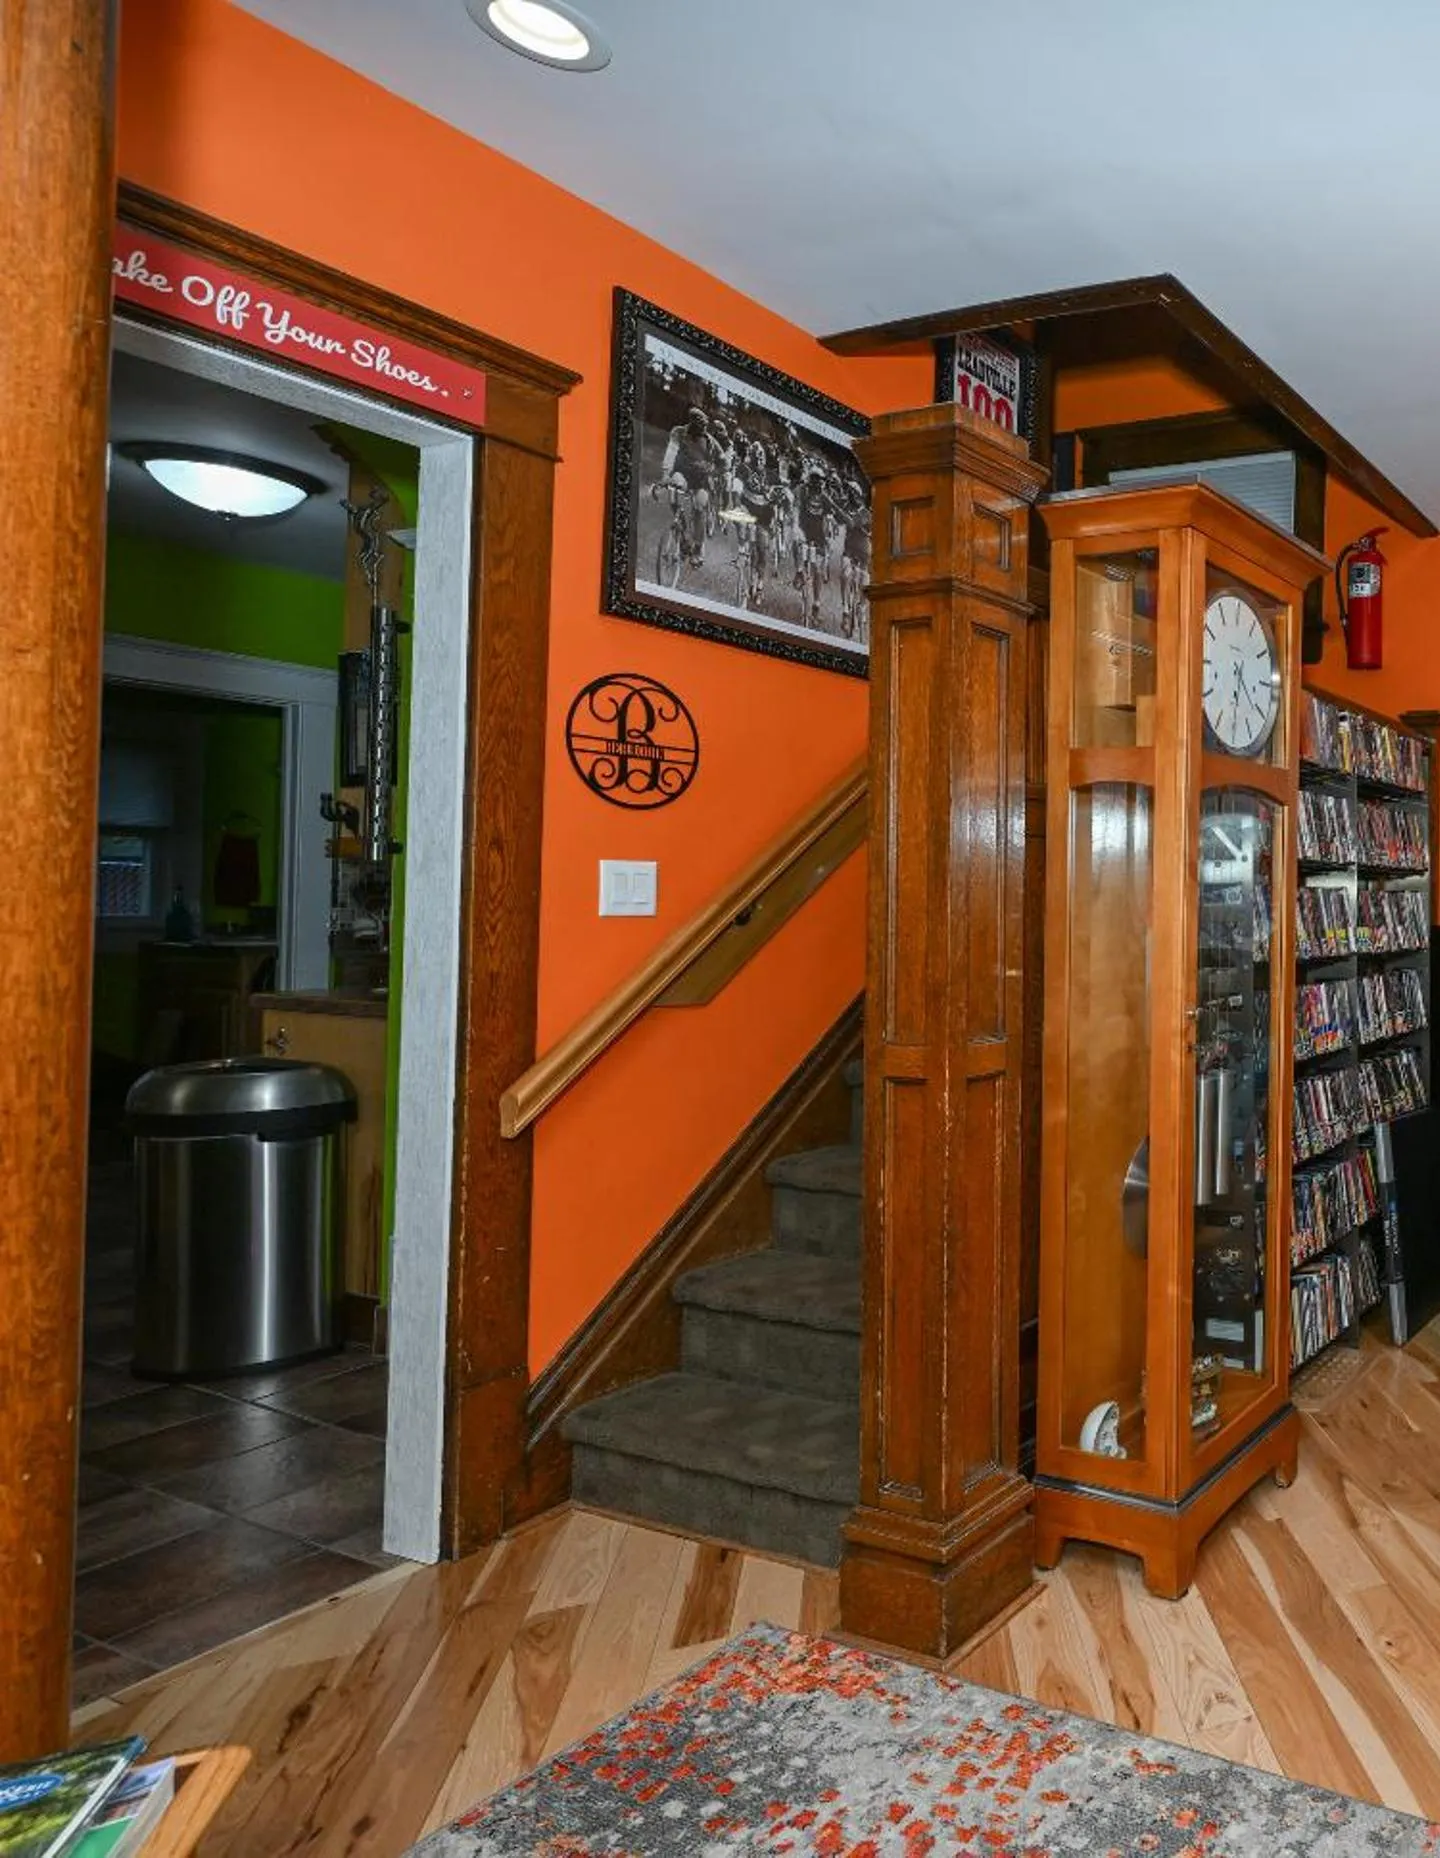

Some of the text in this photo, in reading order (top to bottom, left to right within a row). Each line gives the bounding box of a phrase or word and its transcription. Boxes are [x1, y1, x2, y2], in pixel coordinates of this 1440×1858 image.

[111, 250, 173, 292] ake
[181, 275, 251, 330] Off
[256, 301, 347, 354] Your
